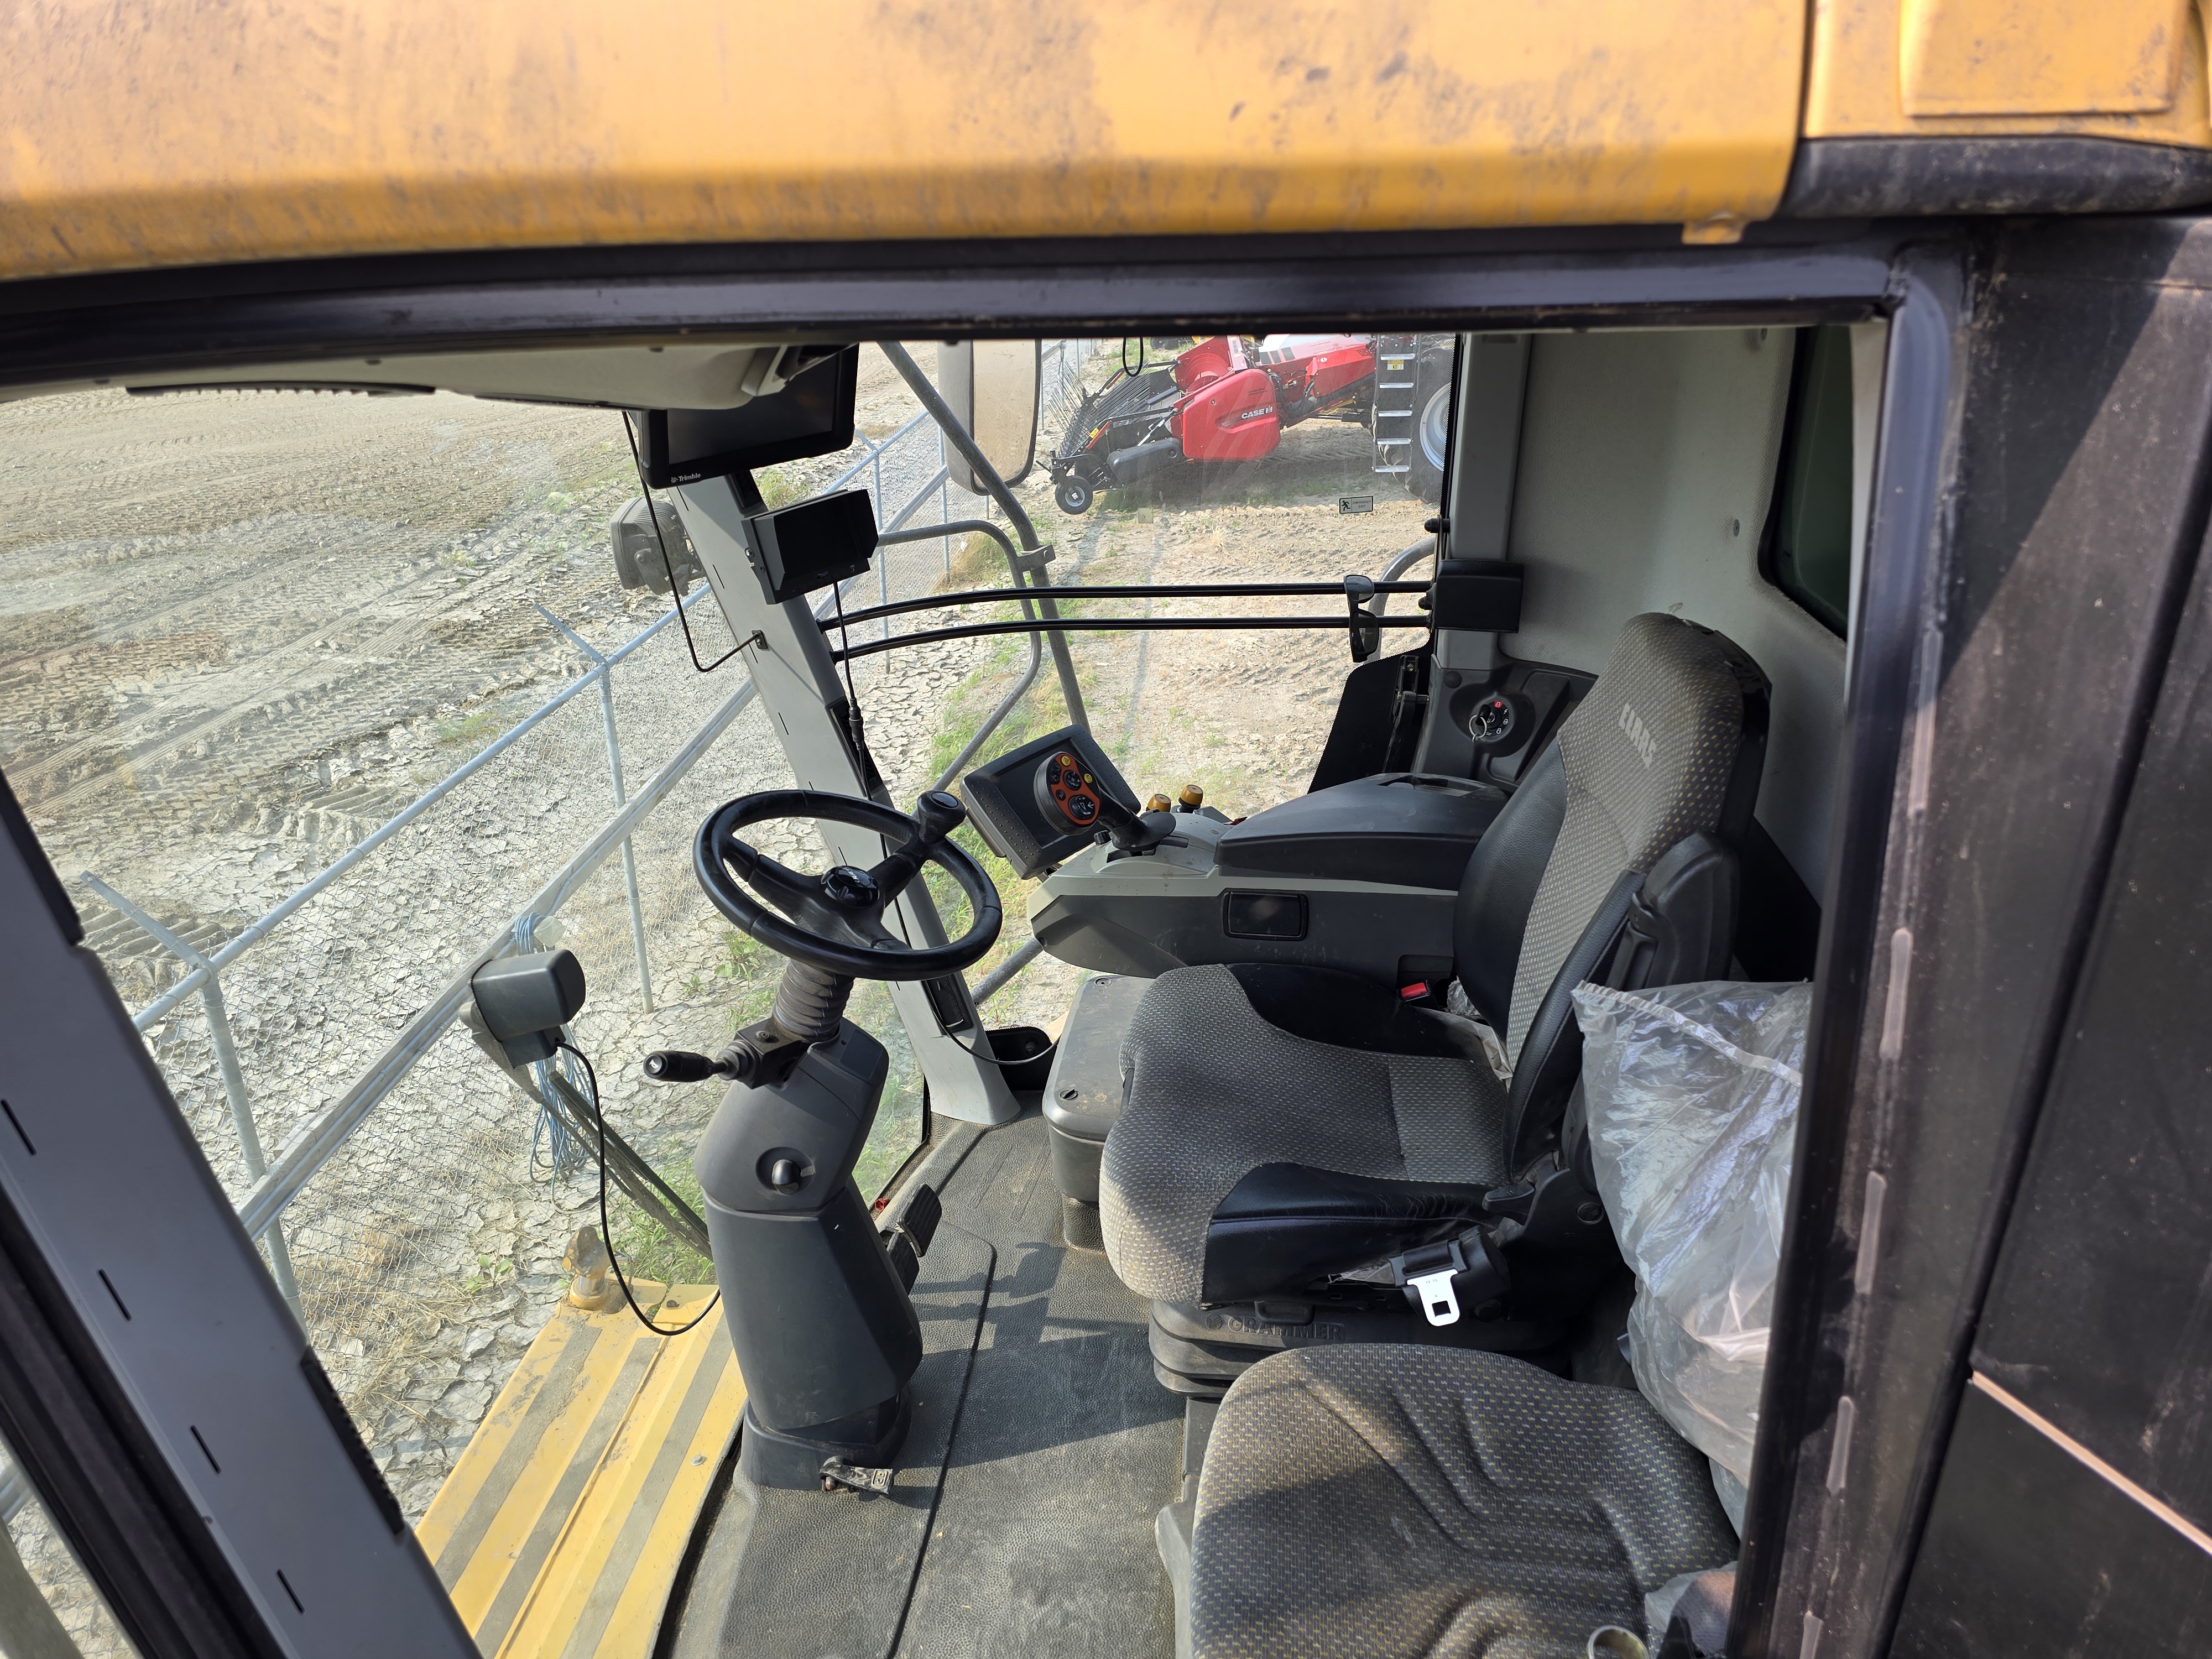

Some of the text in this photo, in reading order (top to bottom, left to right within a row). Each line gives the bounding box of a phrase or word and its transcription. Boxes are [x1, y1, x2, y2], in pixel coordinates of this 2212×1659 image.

[1241, 409, 1265, 419] CASE
[678, 472, 701, 482] Trimble
[1618, 702, 1657, 770] CLAAS
[1227, 1316, 1343, 1340] GRAMMER
